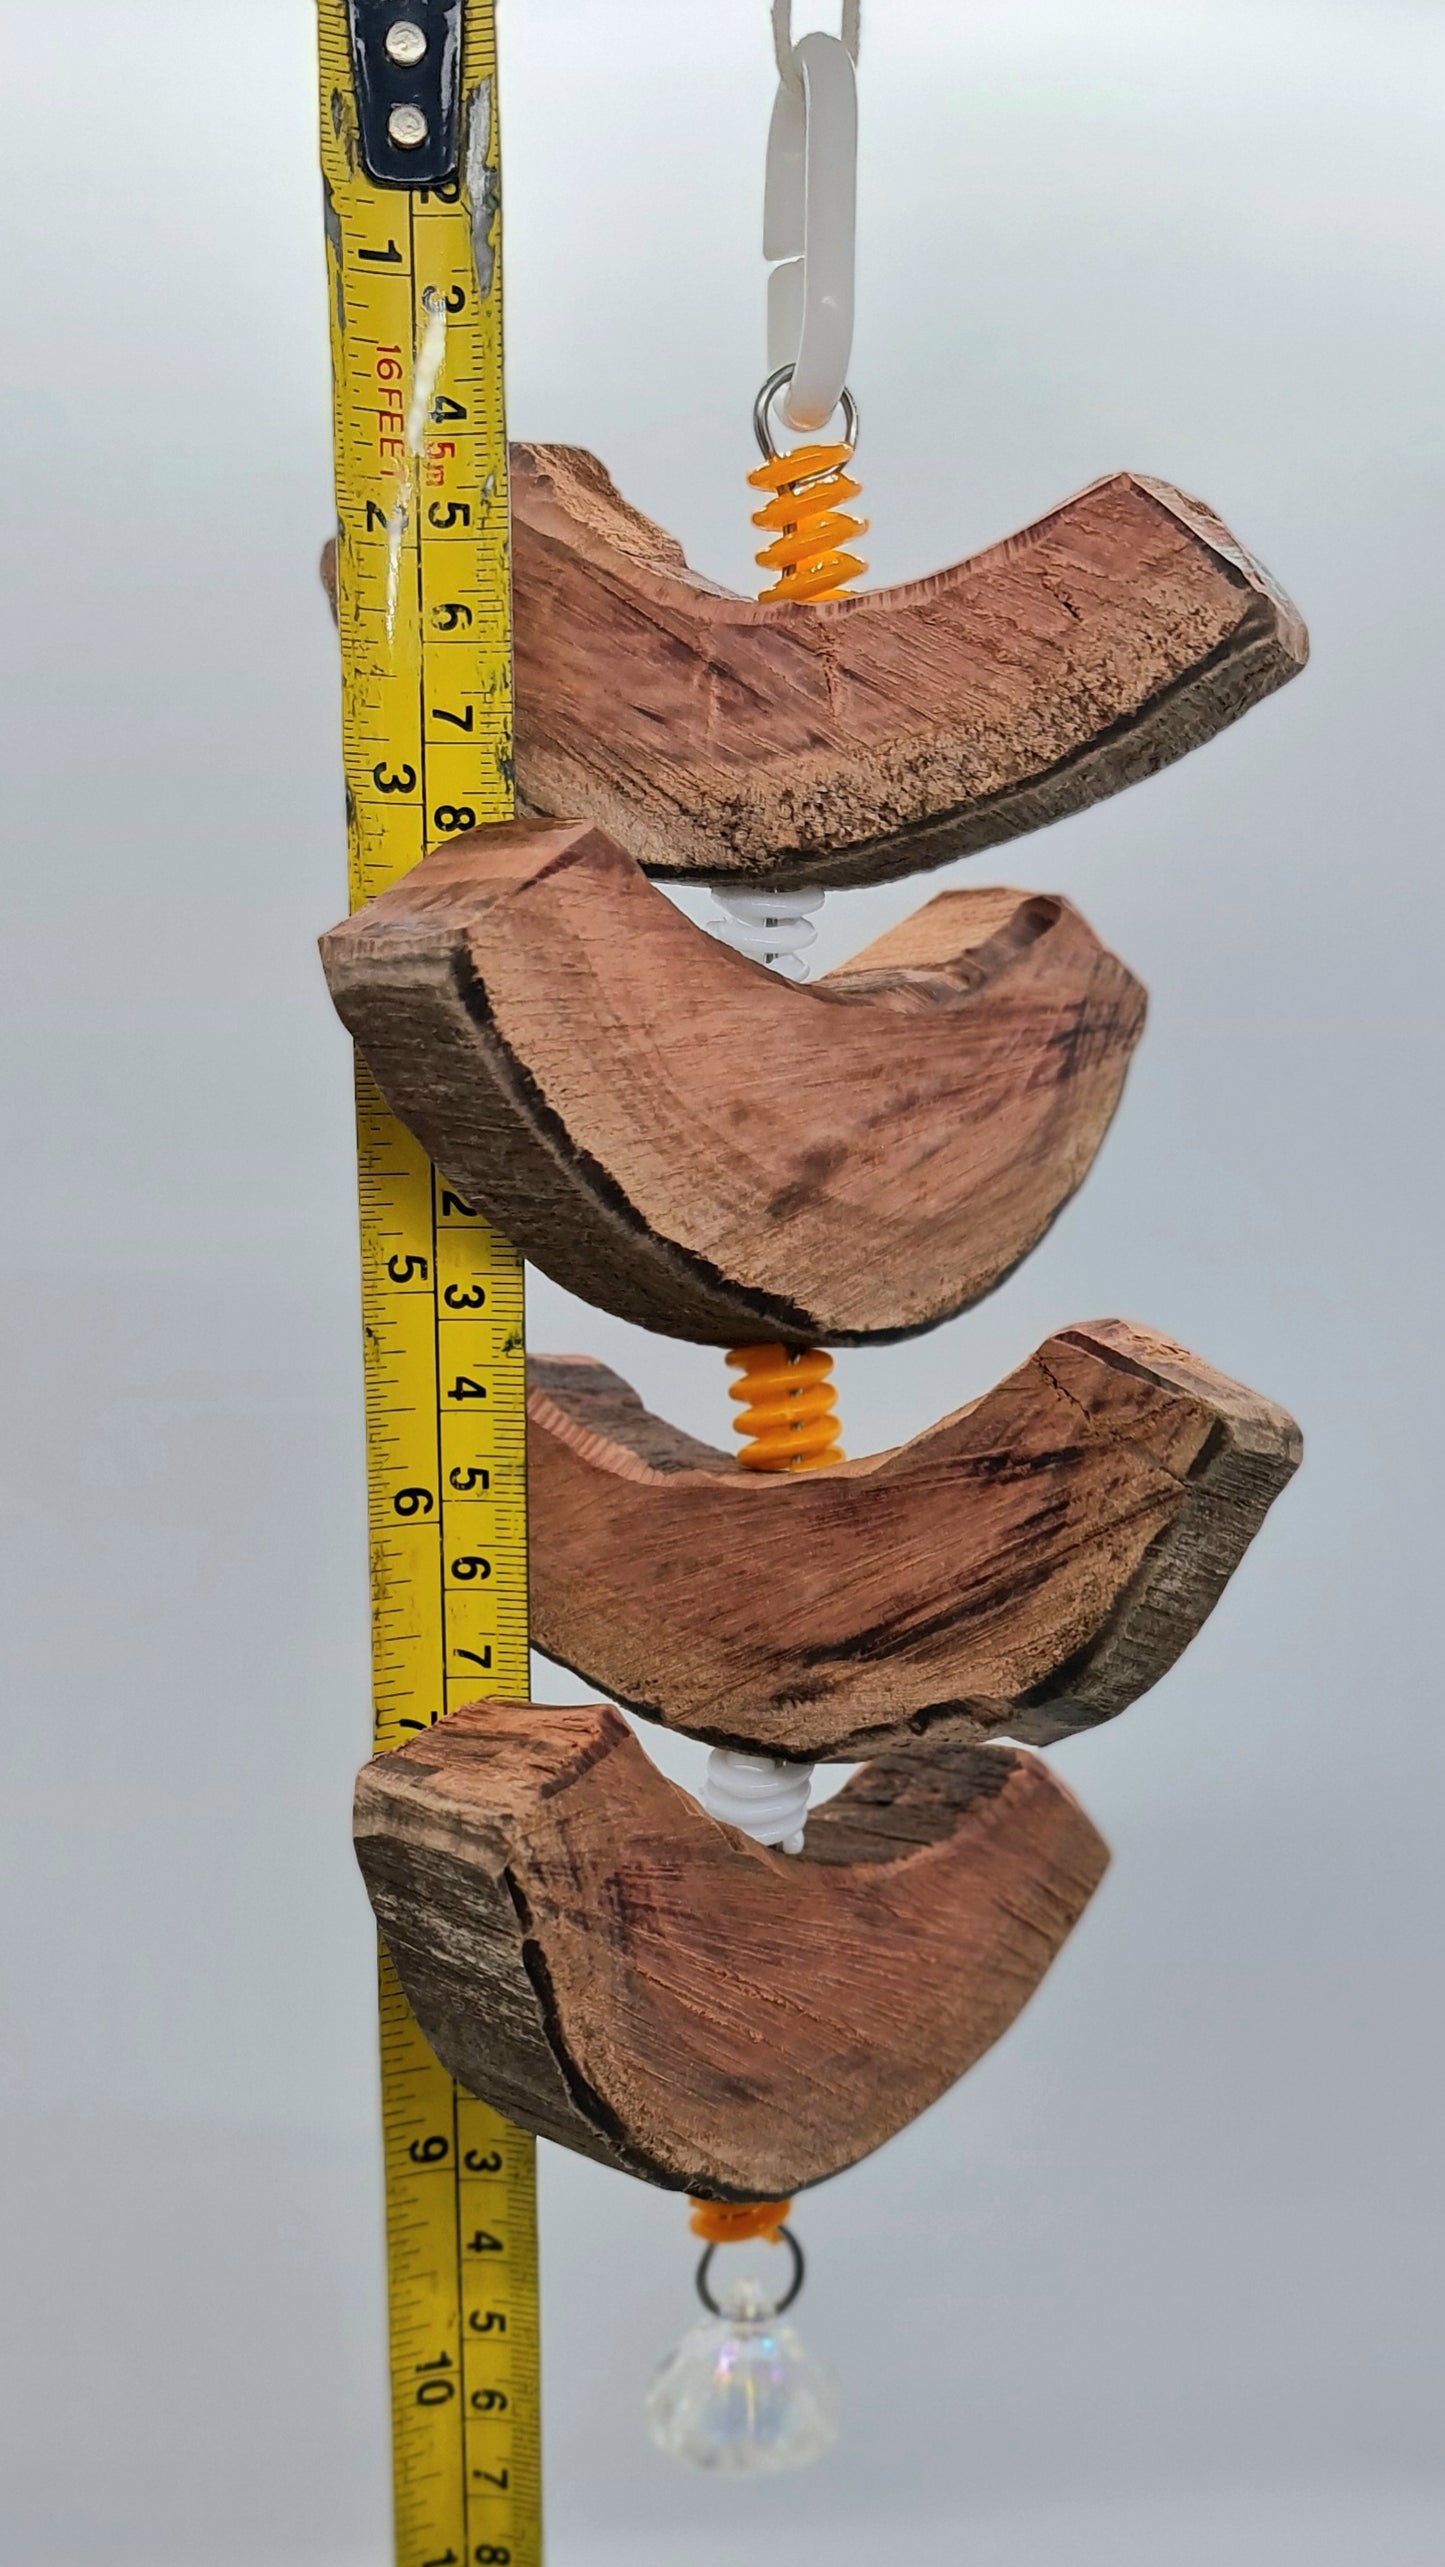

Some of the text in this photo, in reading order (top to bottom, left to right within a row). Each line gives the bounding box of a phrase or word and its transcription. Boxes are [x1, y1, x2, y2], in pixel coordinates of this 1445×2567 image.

[358, 239, 402, 263] 1
[422, 285, 466, 314] 3
[428, 395, 467, 423] 4
[366, 500, 408, 532] 2
[428, 501, 470, 529] 5
[432, 603, 473, 631] 6
[432, 705, 473, 732] 7
[373, 762, 417, 794] 3
[434, 805, 476, 832] 8
[442, 1190, 478, 1217] 2
[388, 1254, 428, 1283] 5
[443, 1284, 486, 1309] 3
[447, 1376, 487, 1401] 4
[449, 1467, 490, 1491] 5
[394, 1487, 434, 1516] 6
[451, 1556, 491, 1580] 6
[453, 1645, 492, 1669] 7
[409, 2136, 449, 2164] 9
[464, 2150, 503, 2173] 3
[467, 2230, 503, 2253] 4
[469, 2310, 506, 2333] 5
[415, 2351, 455, 2406] 10
[471, 2389, 508, 2412] 6
[472, 2469, 508, 2490] 7
[475, 2543, 511, 2566] 8
